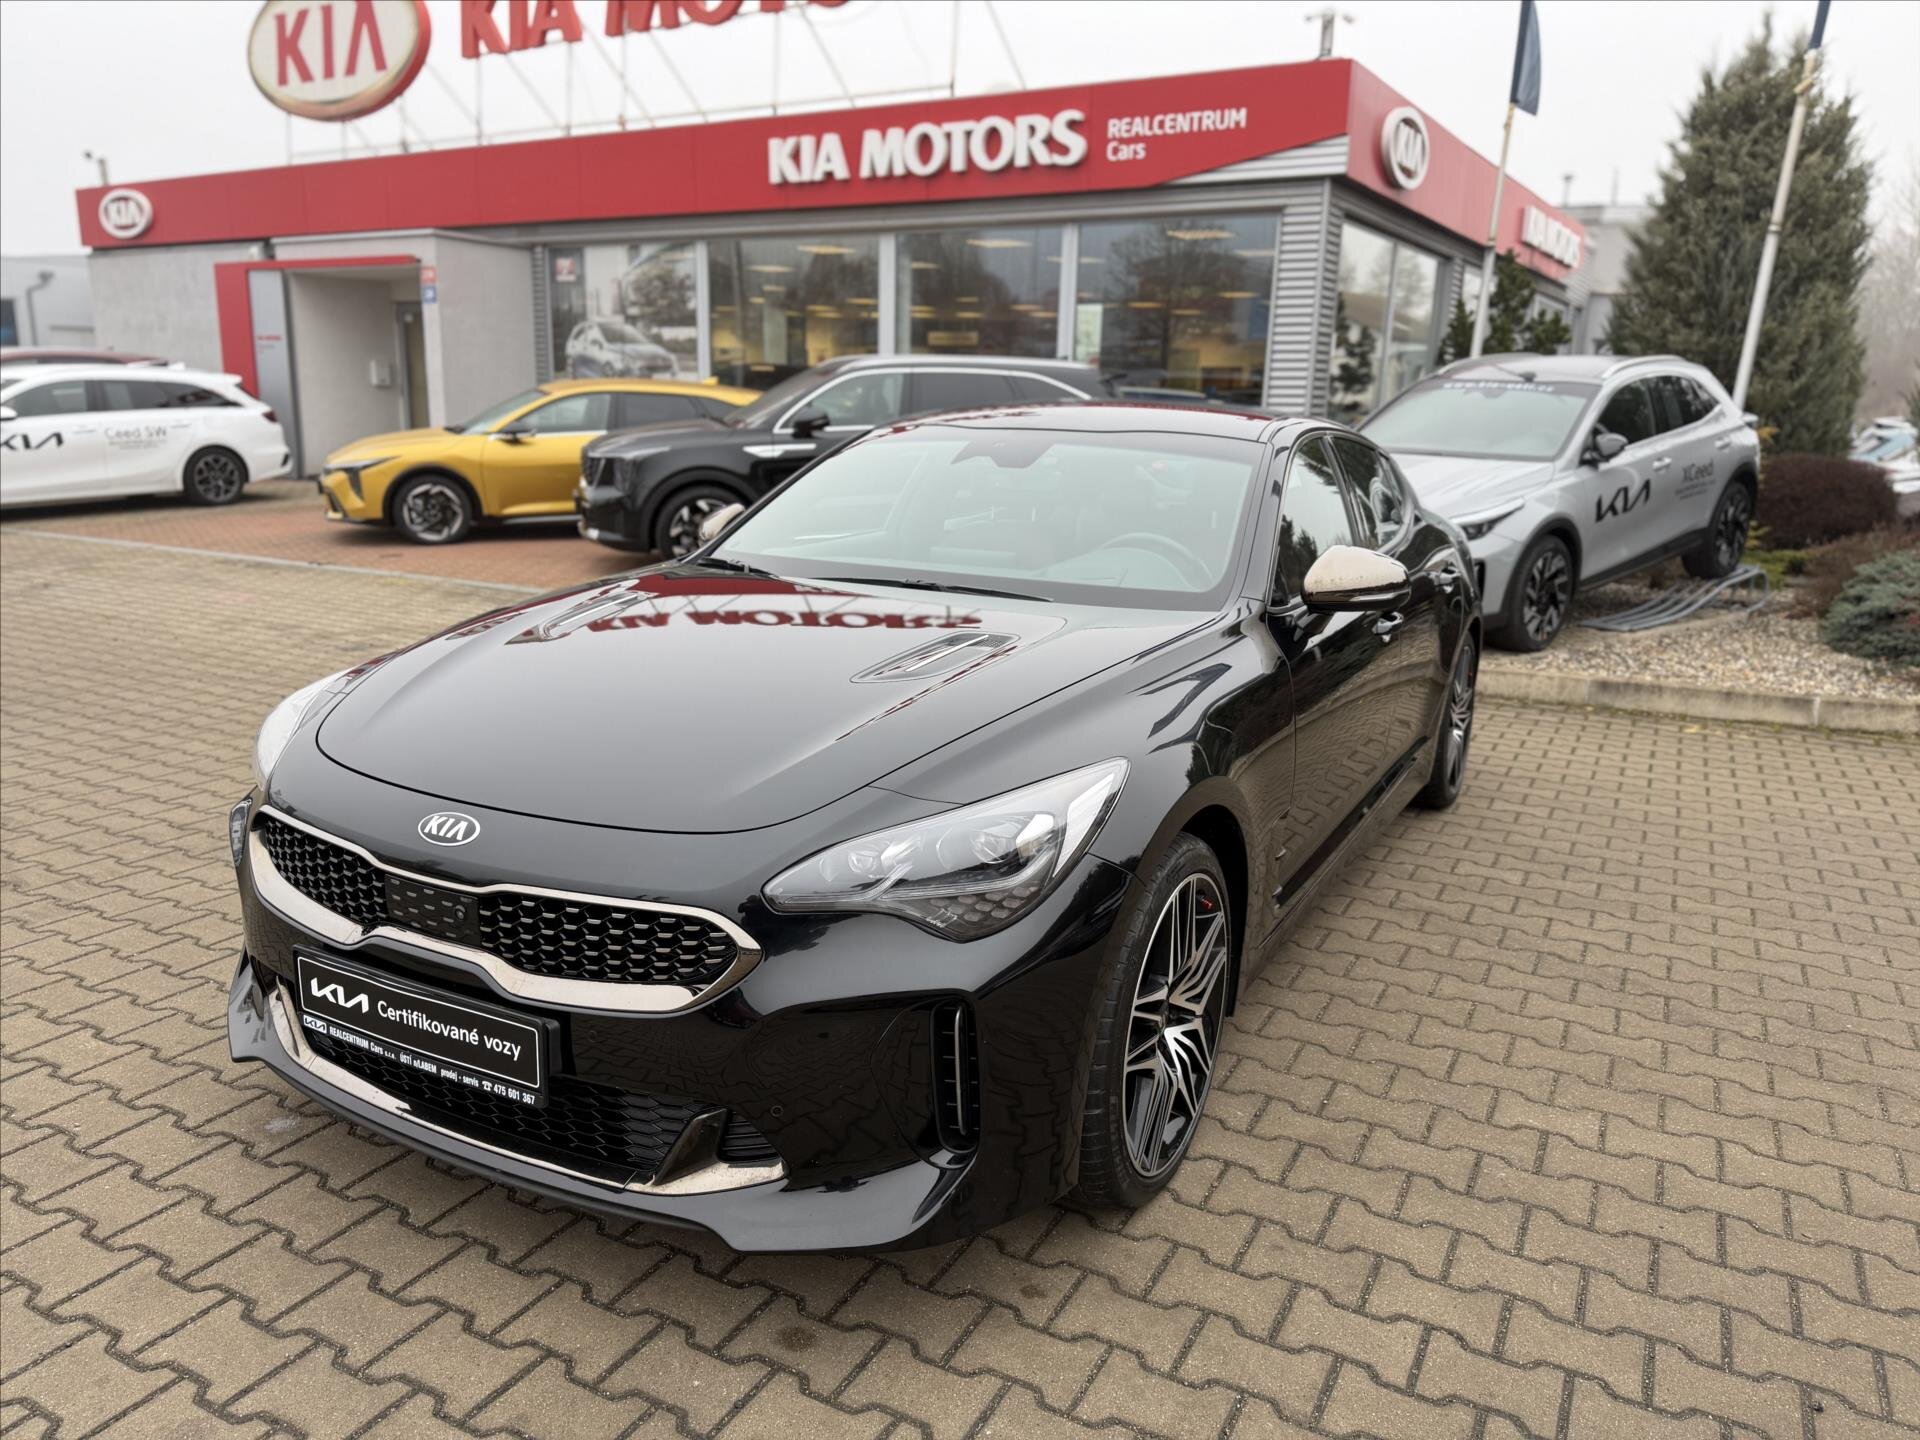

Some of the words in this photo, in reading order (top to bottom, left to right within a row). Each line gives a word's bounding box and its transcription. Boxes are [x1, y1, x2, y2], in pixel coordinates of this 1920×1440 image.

[275, 3, 387, 87] KIA
[768, 133, 850, 185] KIA
[860, 109, 1088, 179] MOTORS
[1106, 140, 1147, 161] Cars
[1107, 107, 1248, 139] REALCENTRUM
[1595, 479, 1650, 523] KIA
[423, 815, 469, 841] KIA
[311, 977, 369, 1014] KIA
[378, 1000, 479, 1045] Certifikované
[484, 1035, 521, 1061] vozy
[329, 1026, 369, 1050] REALCENTRUM
[370, 1042, 383, 1055] Cars
[440, 1068, 458, 1082] prodej
[462, 1075, 479, 1088] servis
[494, 1083, 506, 1097] 475
[507, 1088, 520, 1100] 601
[521, 1093, 535, 1105] 367
